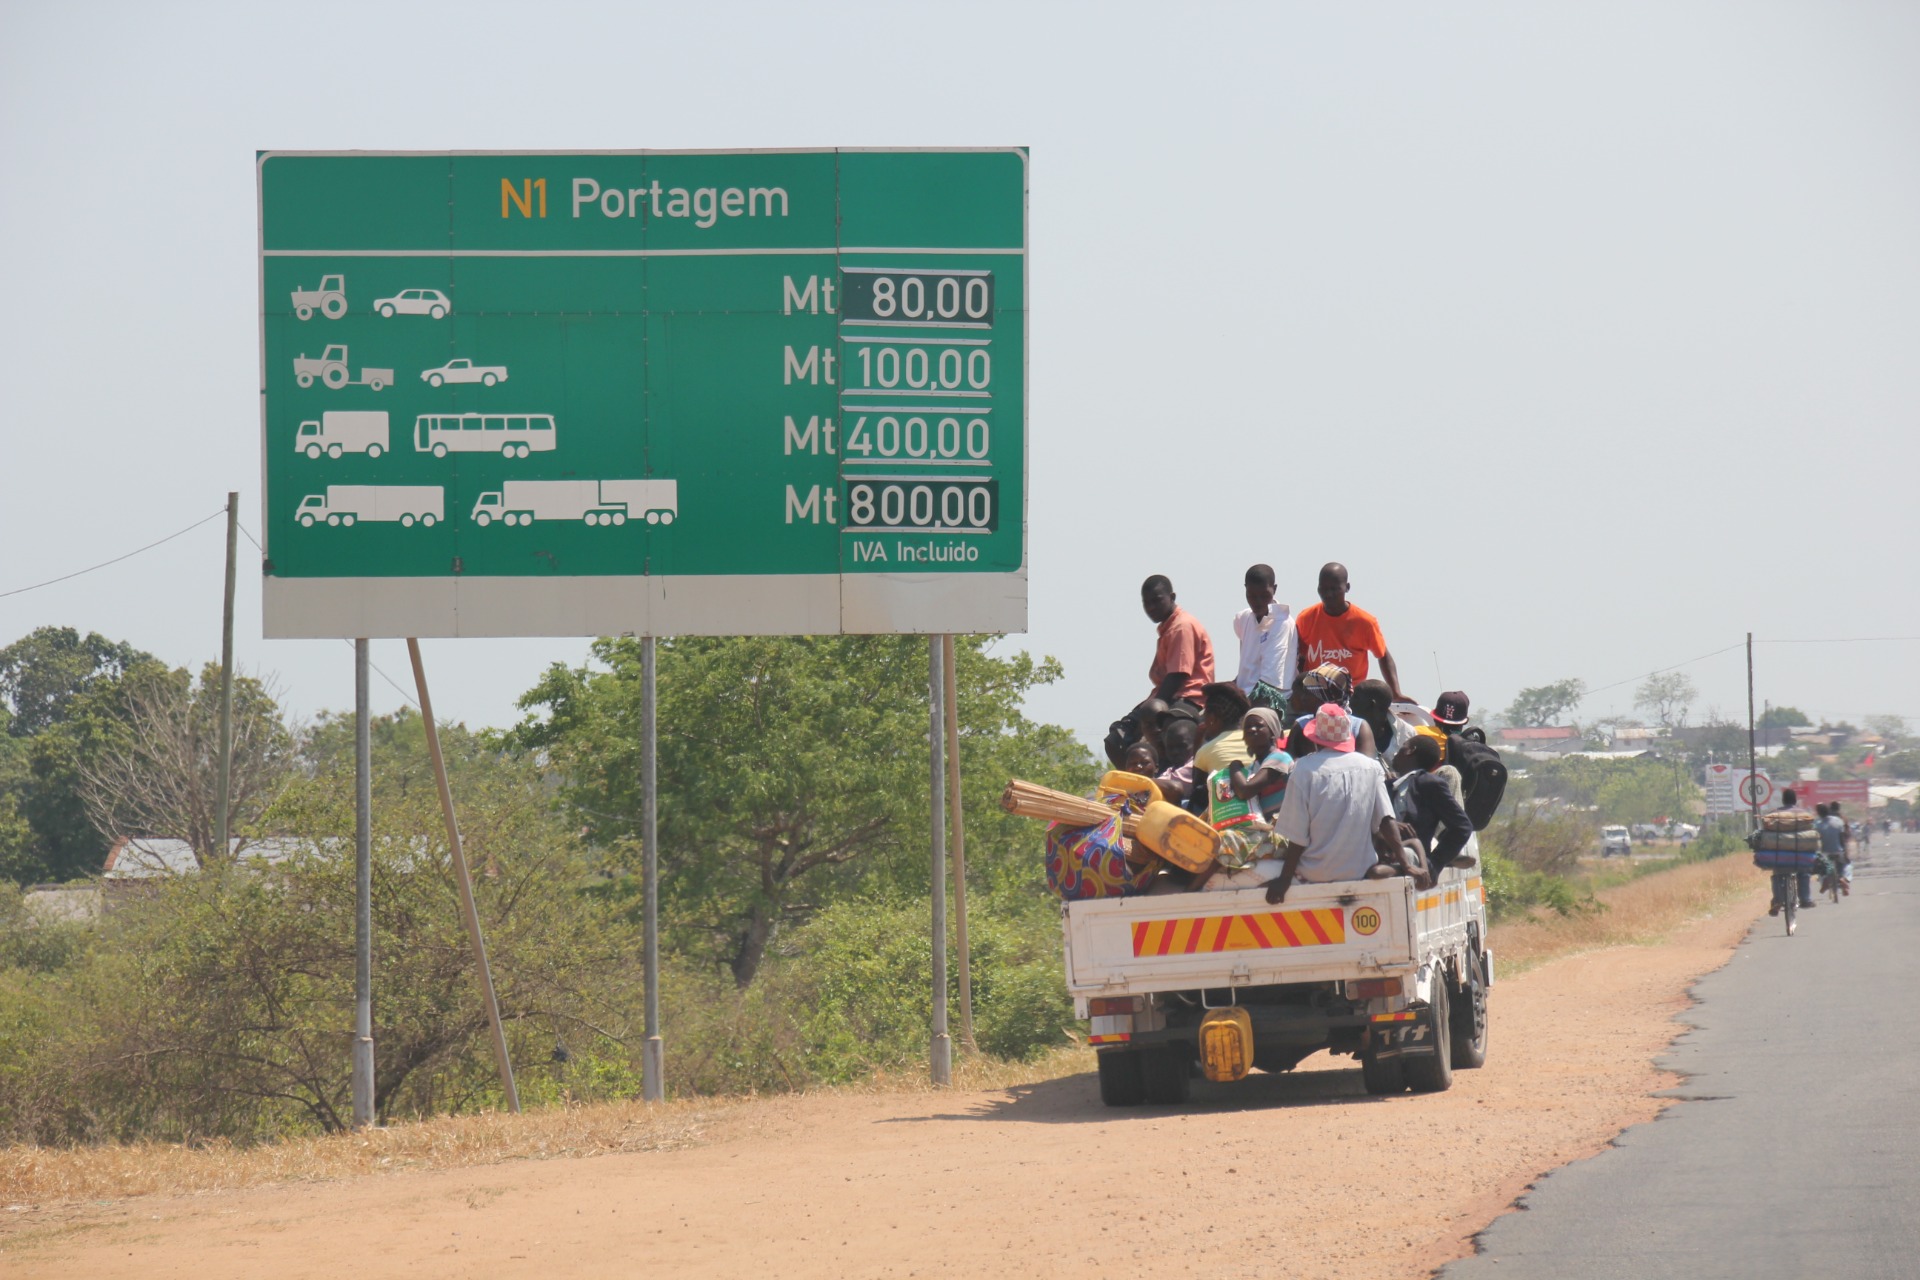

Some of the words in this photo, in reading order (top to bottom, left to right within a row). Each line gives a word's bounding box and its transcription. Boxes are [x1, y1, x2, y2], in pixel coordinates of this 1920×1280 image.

[500, 178, 547, 219] N1
[572, 178, 789, 228] Portagem
[783, 275, 836, 316] Mt
[872, 277, 989, 320] 80,00
[783, 345, 836, 385] Mt
[858, 347, 990, 391] 100,00
[783, 415, 836, 456] Mt
[846, 416, 989, 459] 400,00
[785, 484, 837, 524] Mt
[850, 484, 991, 528] 800,00
[853, 541, 888, 562] IVA
[897, 541, 979, 562] Incluido
[1356, 914, 1377, 928] 100
